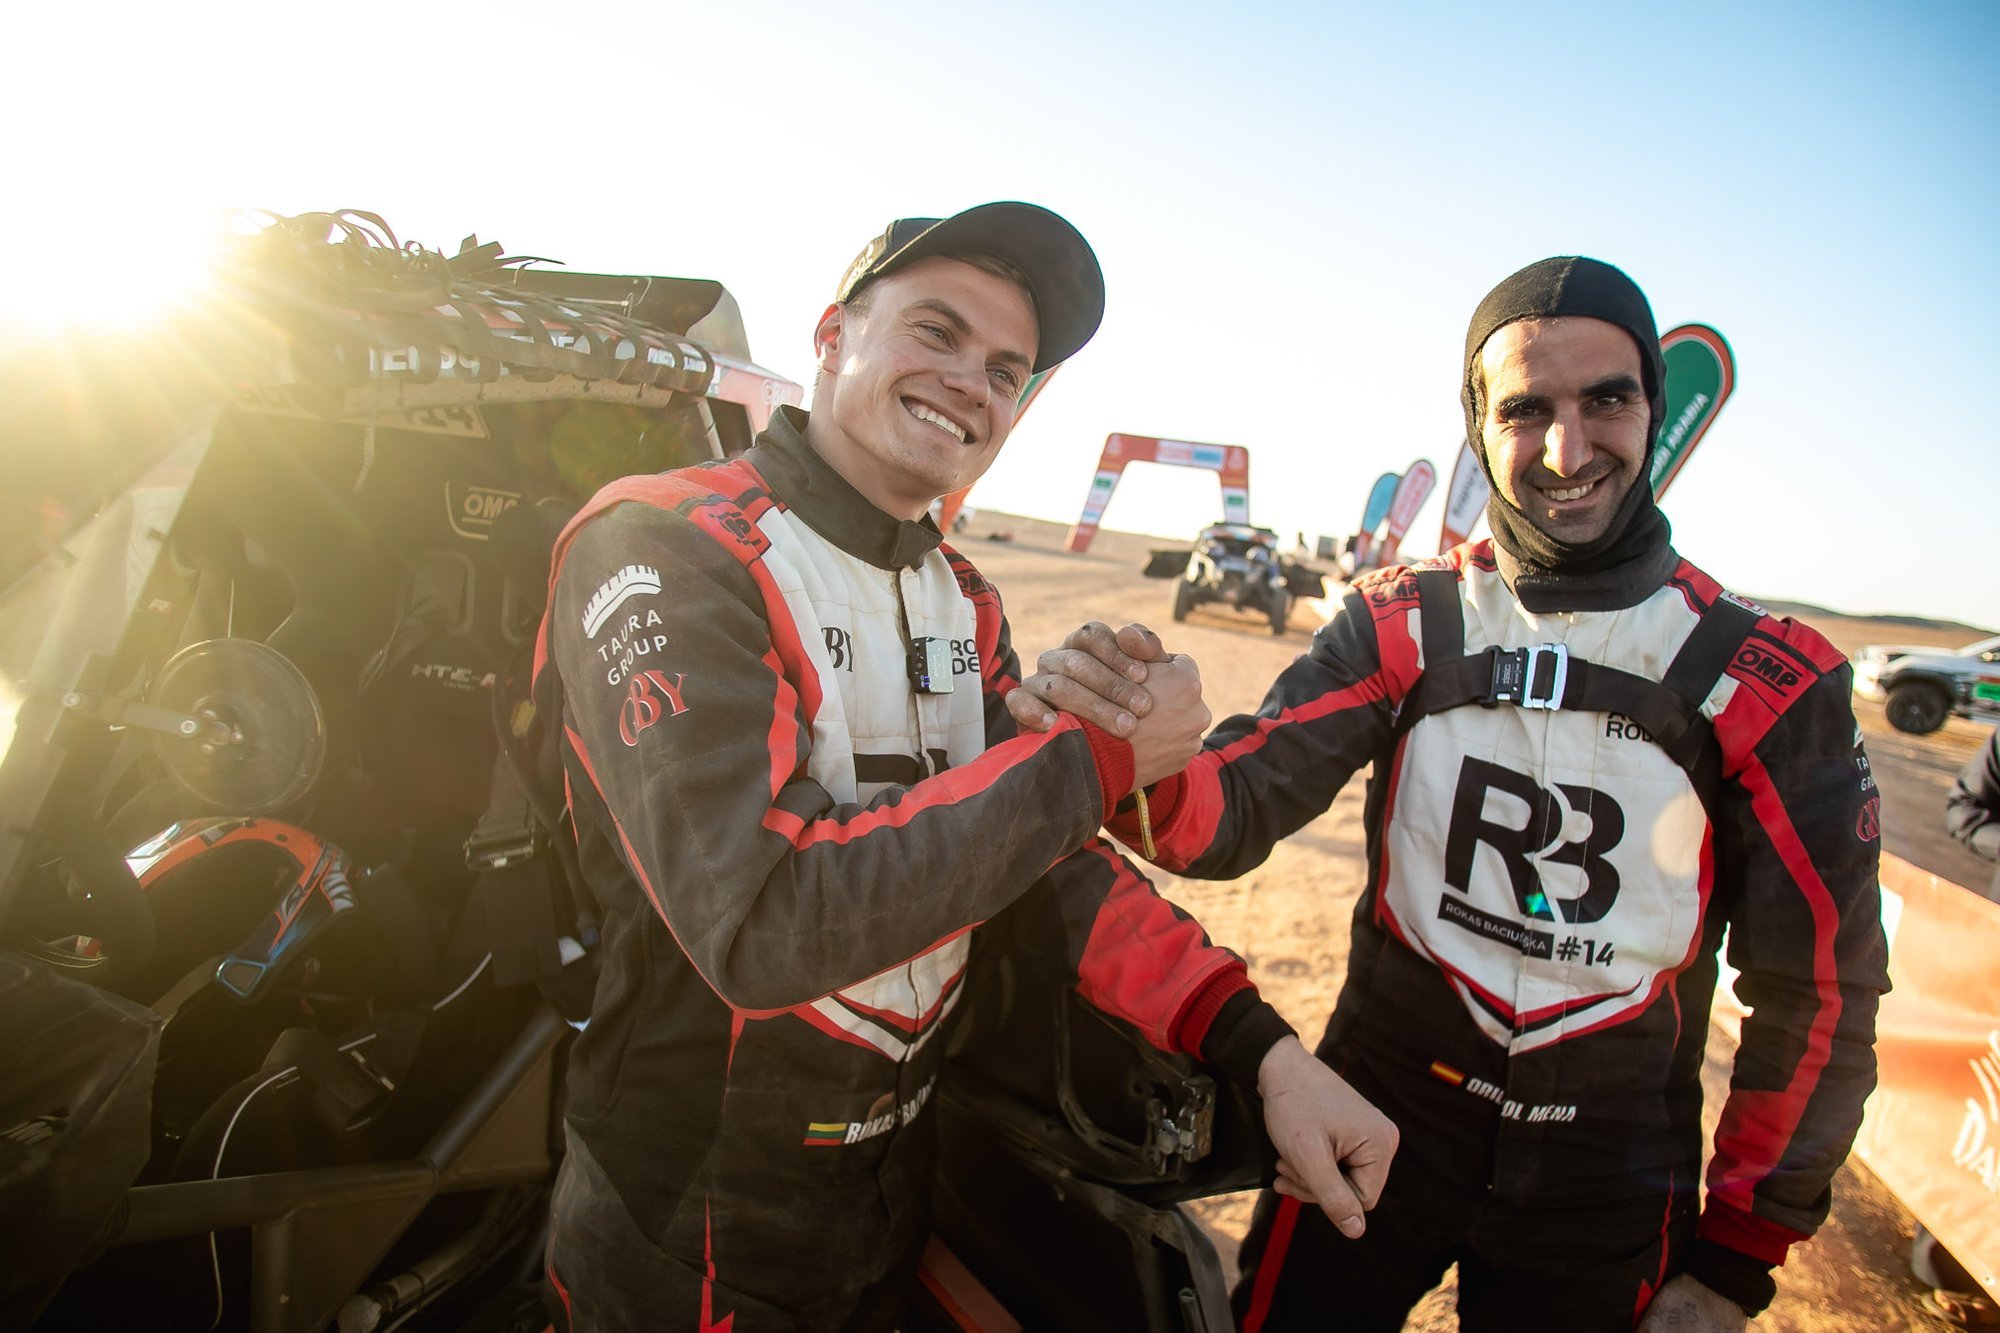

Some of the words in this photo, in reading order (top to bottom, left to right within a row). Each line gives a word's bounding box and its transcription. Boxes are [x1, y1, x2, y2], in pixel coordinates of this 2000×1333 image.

[1667, 393, 1709, 449] ARABIA
[597, 609, 663, 662] TAURA
[607, 635, 668, 686] GROUP
[1738, 649, 1799, 687] OMP
[1446, 902, 1482, 929] ROKAS
[1556, 935, 1615, 967] #14
[1526, 1105, 1577, 1122] MENA
[1952, 1097, 2000, 1194] DA
